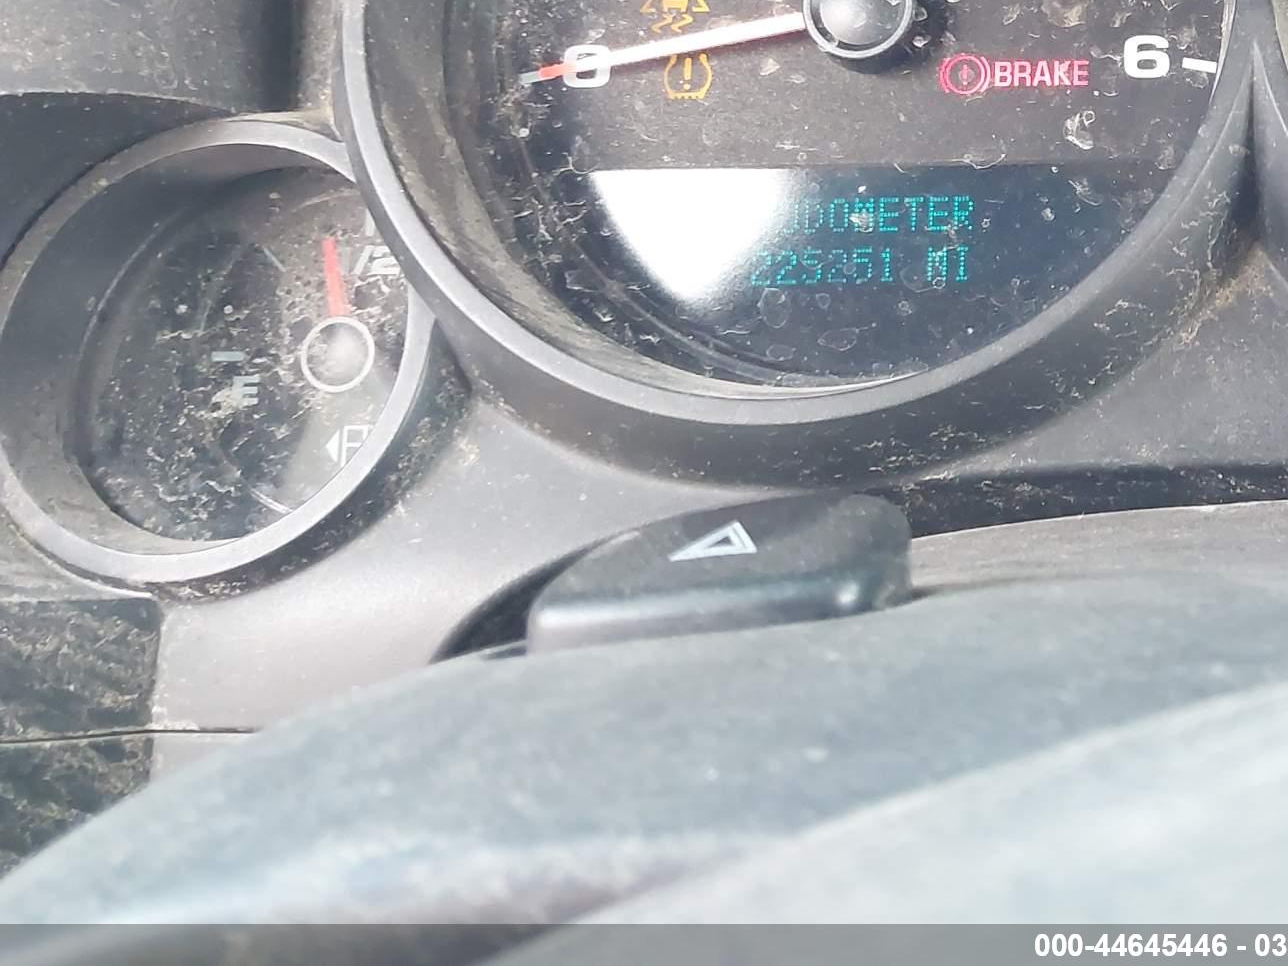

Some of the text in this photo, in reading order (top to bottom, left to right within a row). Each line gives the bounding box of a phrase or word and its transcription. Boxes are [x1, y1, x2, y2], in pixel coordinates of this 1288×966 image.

[563, 44, 611, 88] 0
[994, 60, 1090, 87] BRAKE
[1123, 36, 1171, 79] 6
[927, 245, 969, 283] MI
[232, 375, 260, 410] E
